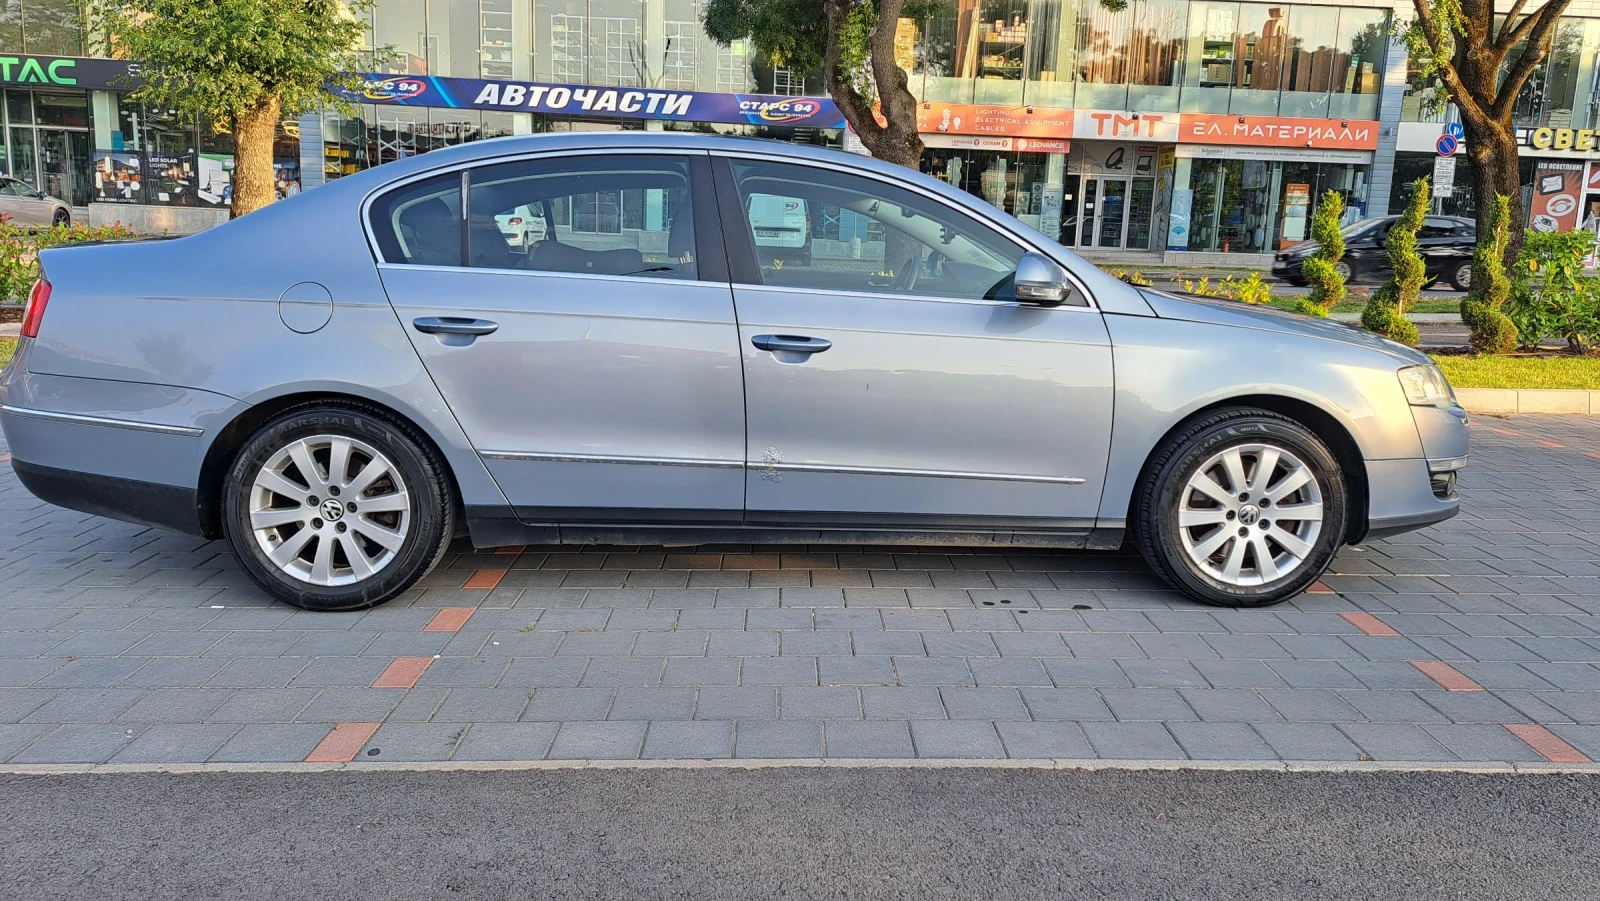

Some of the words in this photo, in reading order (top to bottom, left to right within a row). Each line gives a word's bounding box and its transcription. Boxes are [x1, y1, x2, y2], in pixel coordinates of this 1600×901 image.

[398, 82, 418, 92] 94
[474, 83, 694, 116] АВТОЧАСТИ
[739, 101, 790, 111] СТАРС
[794, 104, 812, 112] 94
[975, 117, 1021, 125] ELECTRICAL
[1024, 119, 1070, 127] EQUIPMENT
[1193, 121, 1228, 136] ЕЛ.
[1233, 123, 1369, 142] МАТЕРИАЛИ
[1533, 127, 1600, 150] СВЕ
[1029, 141, 1064, 149] LEDVANCE
[1548, 163, 1583, 171] ОСВЕТЛЕНИЕ
